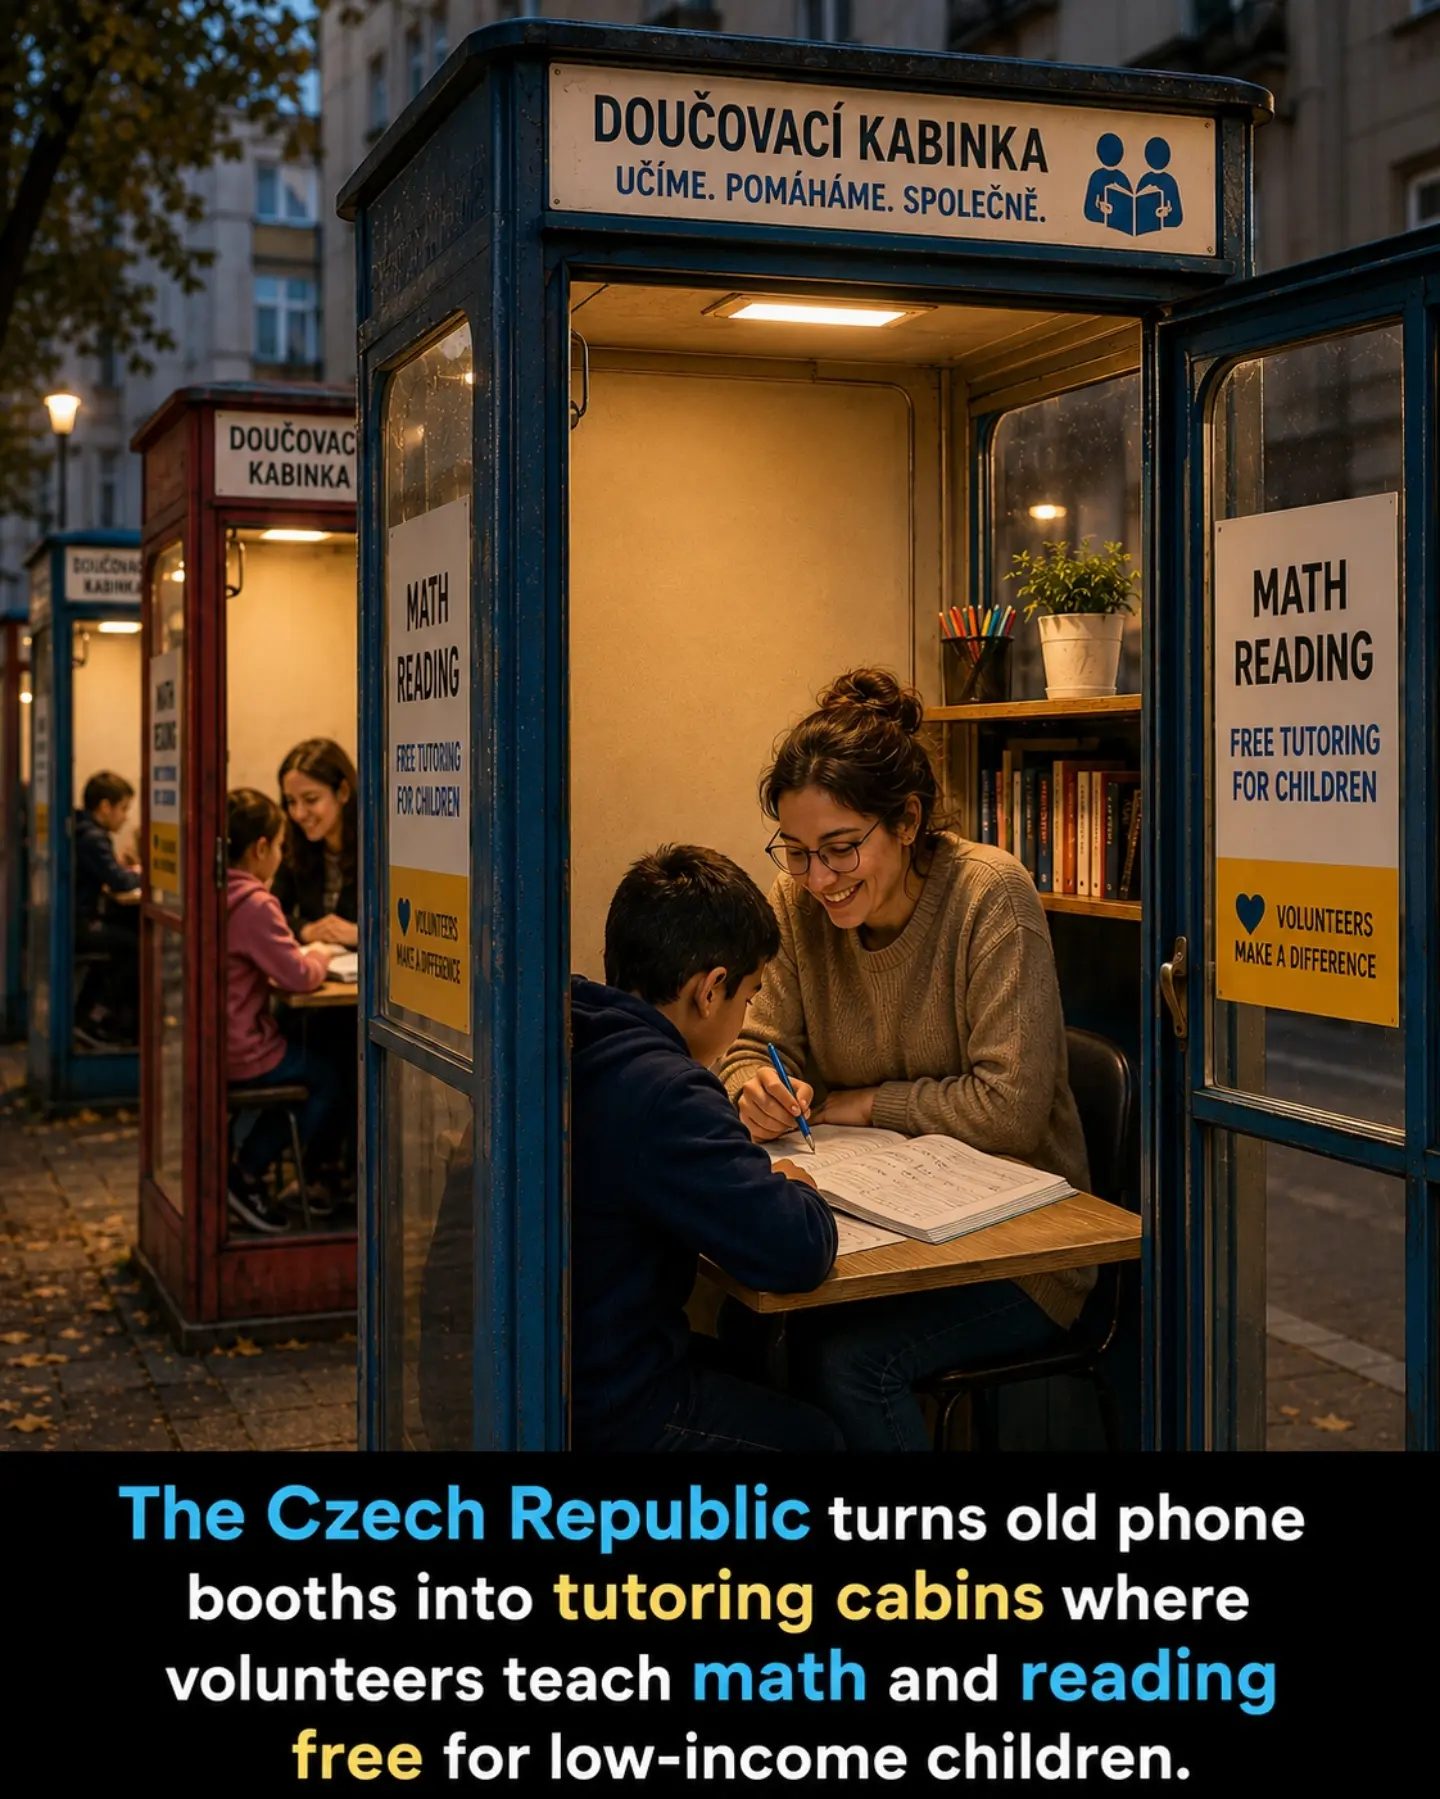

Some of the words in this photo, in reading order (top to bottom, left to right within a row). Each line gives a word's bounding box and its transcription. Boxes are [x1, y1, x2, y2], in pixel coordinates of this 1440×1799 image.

[594, 90, 844, 159] DOUČOVACÍ
[859, 115, 1050, 174] KABINKA
[616, 159, 715, 201] UČÍME.
[726, 170, 894, 212] POMÁHÁME.
[903, 184, 1047, 224] SPOLEČNĚ.
[230, 421, 356, 456] DOUČOVAC
[248, 460, 351, 489] KABINKA
[406, 572, 449, 632] MATH
[1253, 559, 1347, 618] MATH
[397, 645, 460, 704] READING
[1235, 630, 1374, 686] READING
[396, 743, 416, 773] FREE
[417, 741, 462, 773] TUTORING
[1231, 727, 1274, 757] FREE
[1280, 724, 1380, 757] TUTORING
[397, 785, 414, 815] FOR
[415, 785, 461, 818] CHILDREN
[1233, 770, 1270, 801] FOR
[1276, 770, 1377, 803] CHILDREN
[415, 909, 459, 942] VOLUNTEERS
[1277, 904, 1374, 938] VOLUNTEERS
[396, 943, 415, 970] MAKE
[421, 951, 461, 985] DIFFERENCE
[1235, 940, 1273, 967] MAKE
[1276, 944, 1287, 968] A
[1290, 946, 1377, 980] DIFFERENCE
